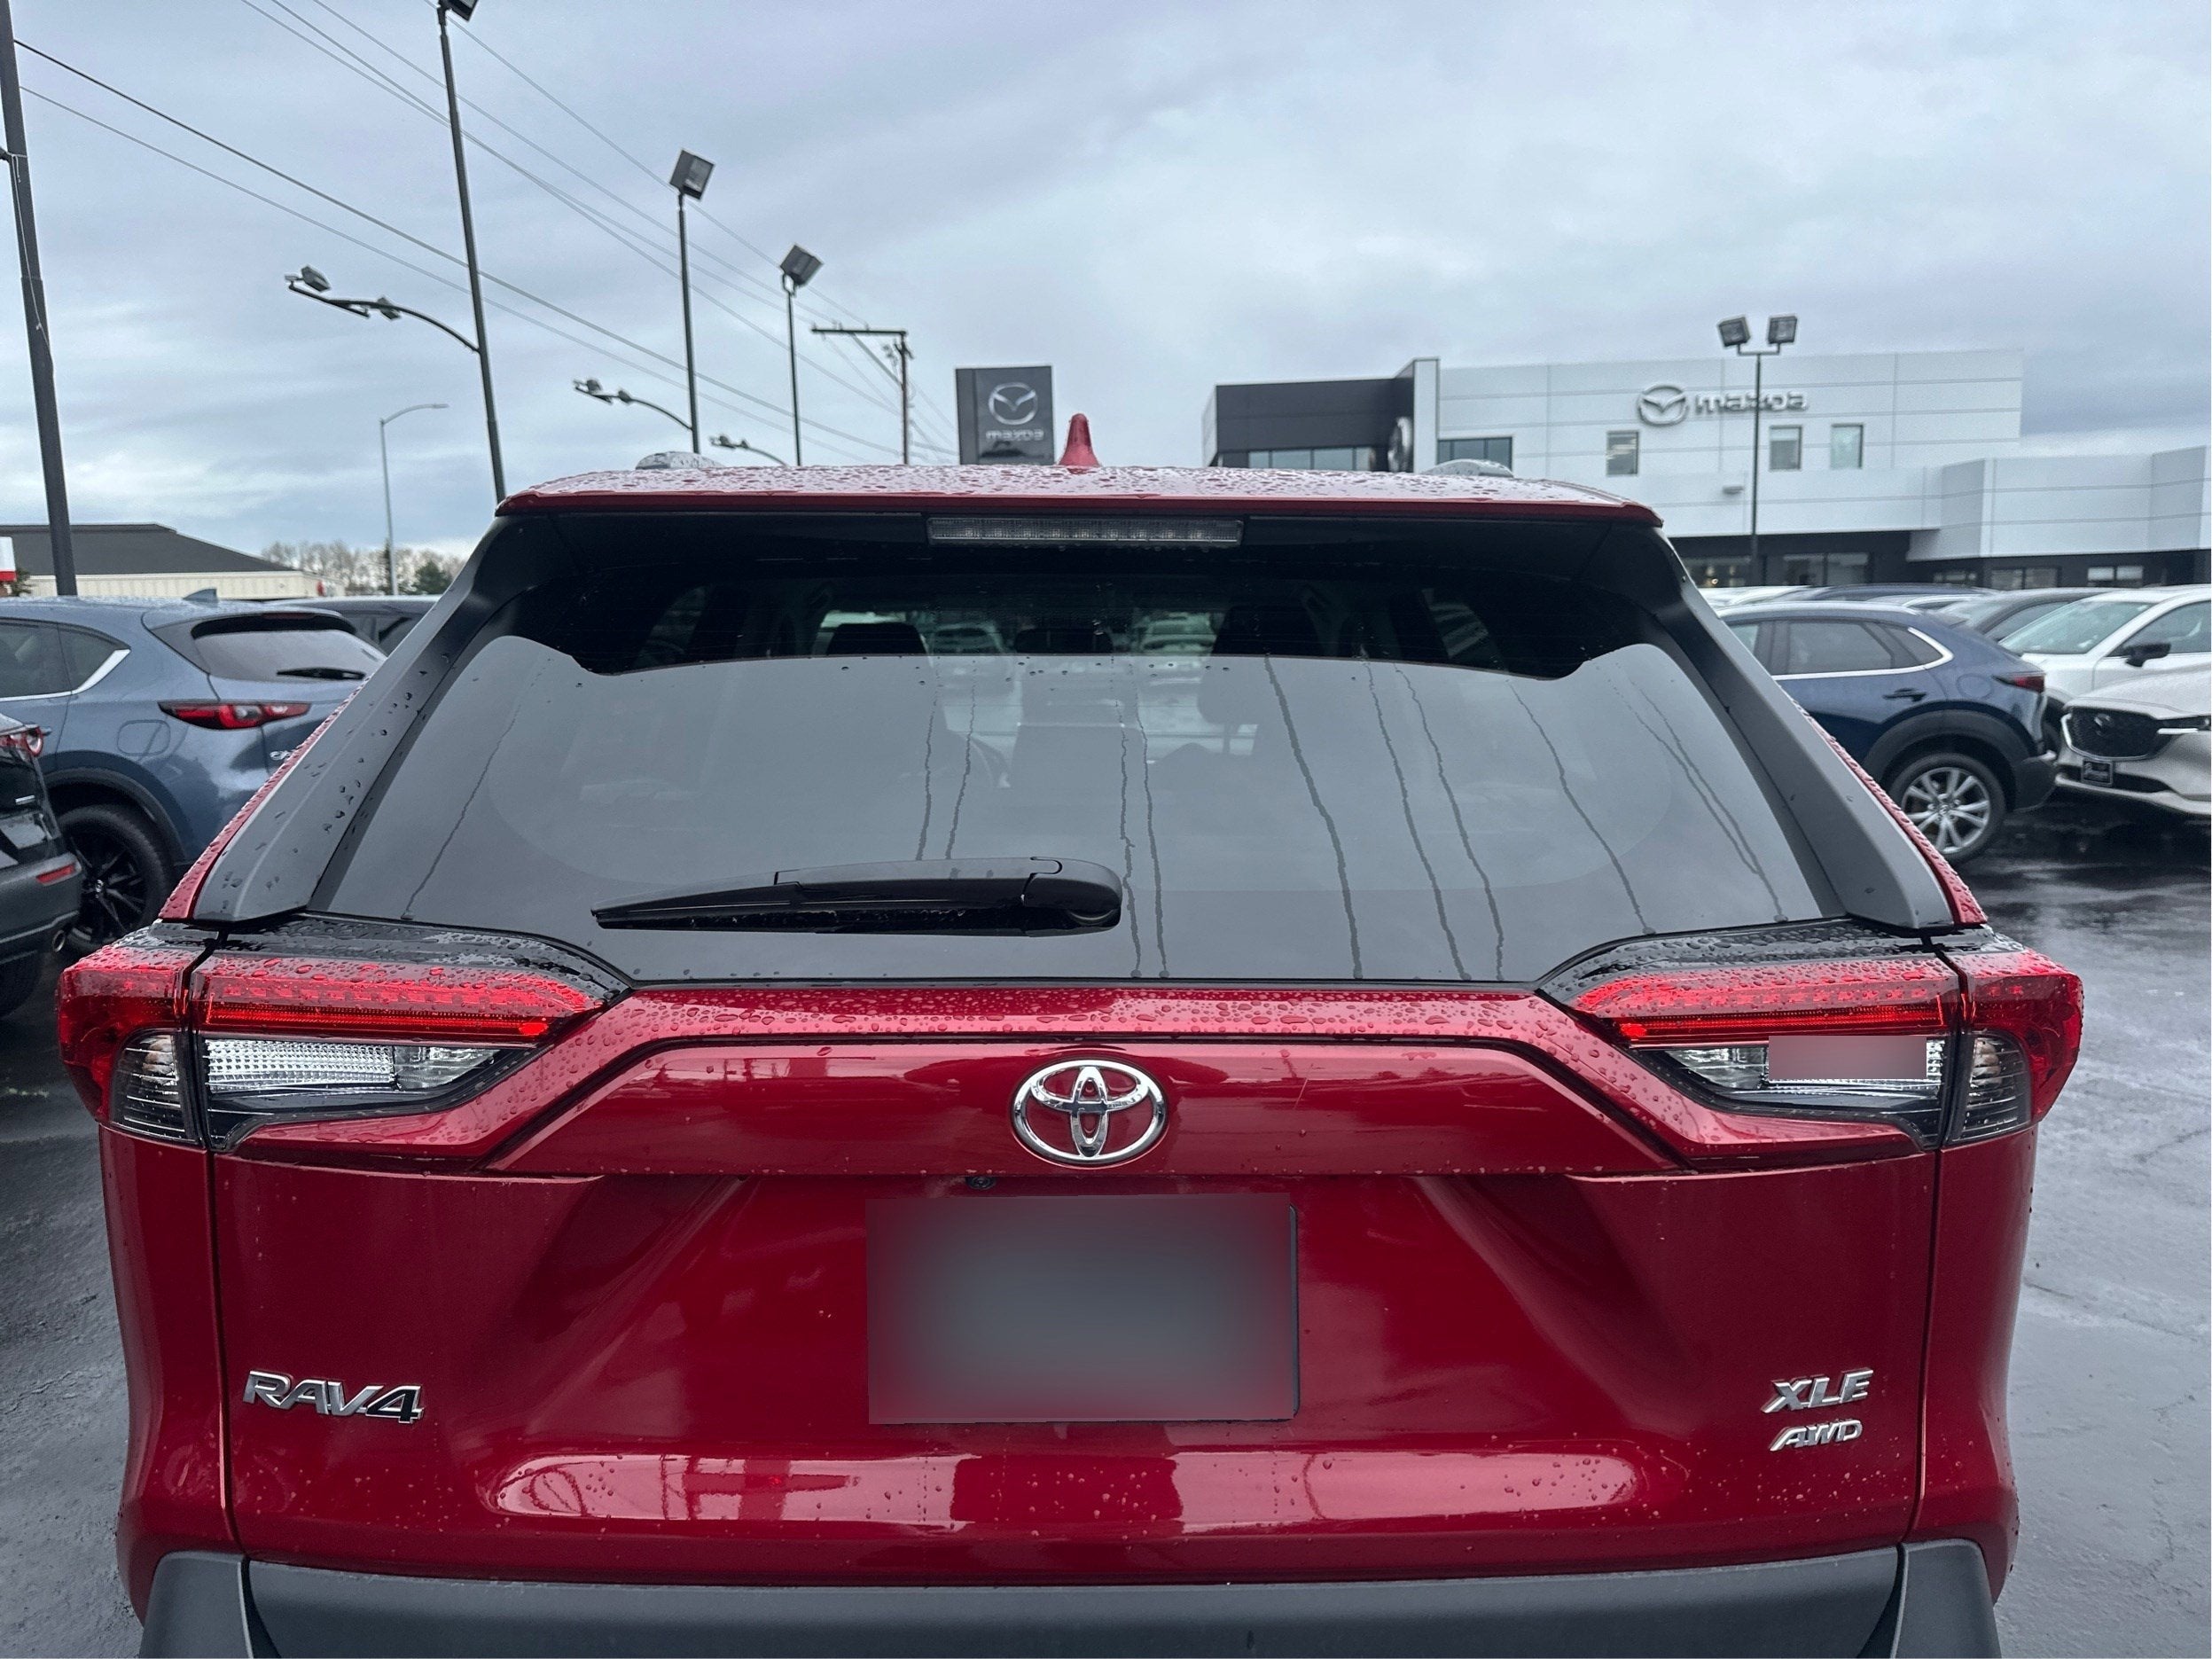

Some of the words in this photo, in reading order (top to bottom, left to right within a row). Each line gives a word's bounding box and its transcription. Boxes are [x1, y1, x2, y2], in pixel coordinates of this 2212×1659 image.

[1694, 392, 1809, 414] mazda
[985, 428, 1044, 442] mazda
[242, 1370, 425, 1424] RAV4
[1760, 1368, 1873, 1413] XLE
[1769, 1419, 1863, 1452] AWD
